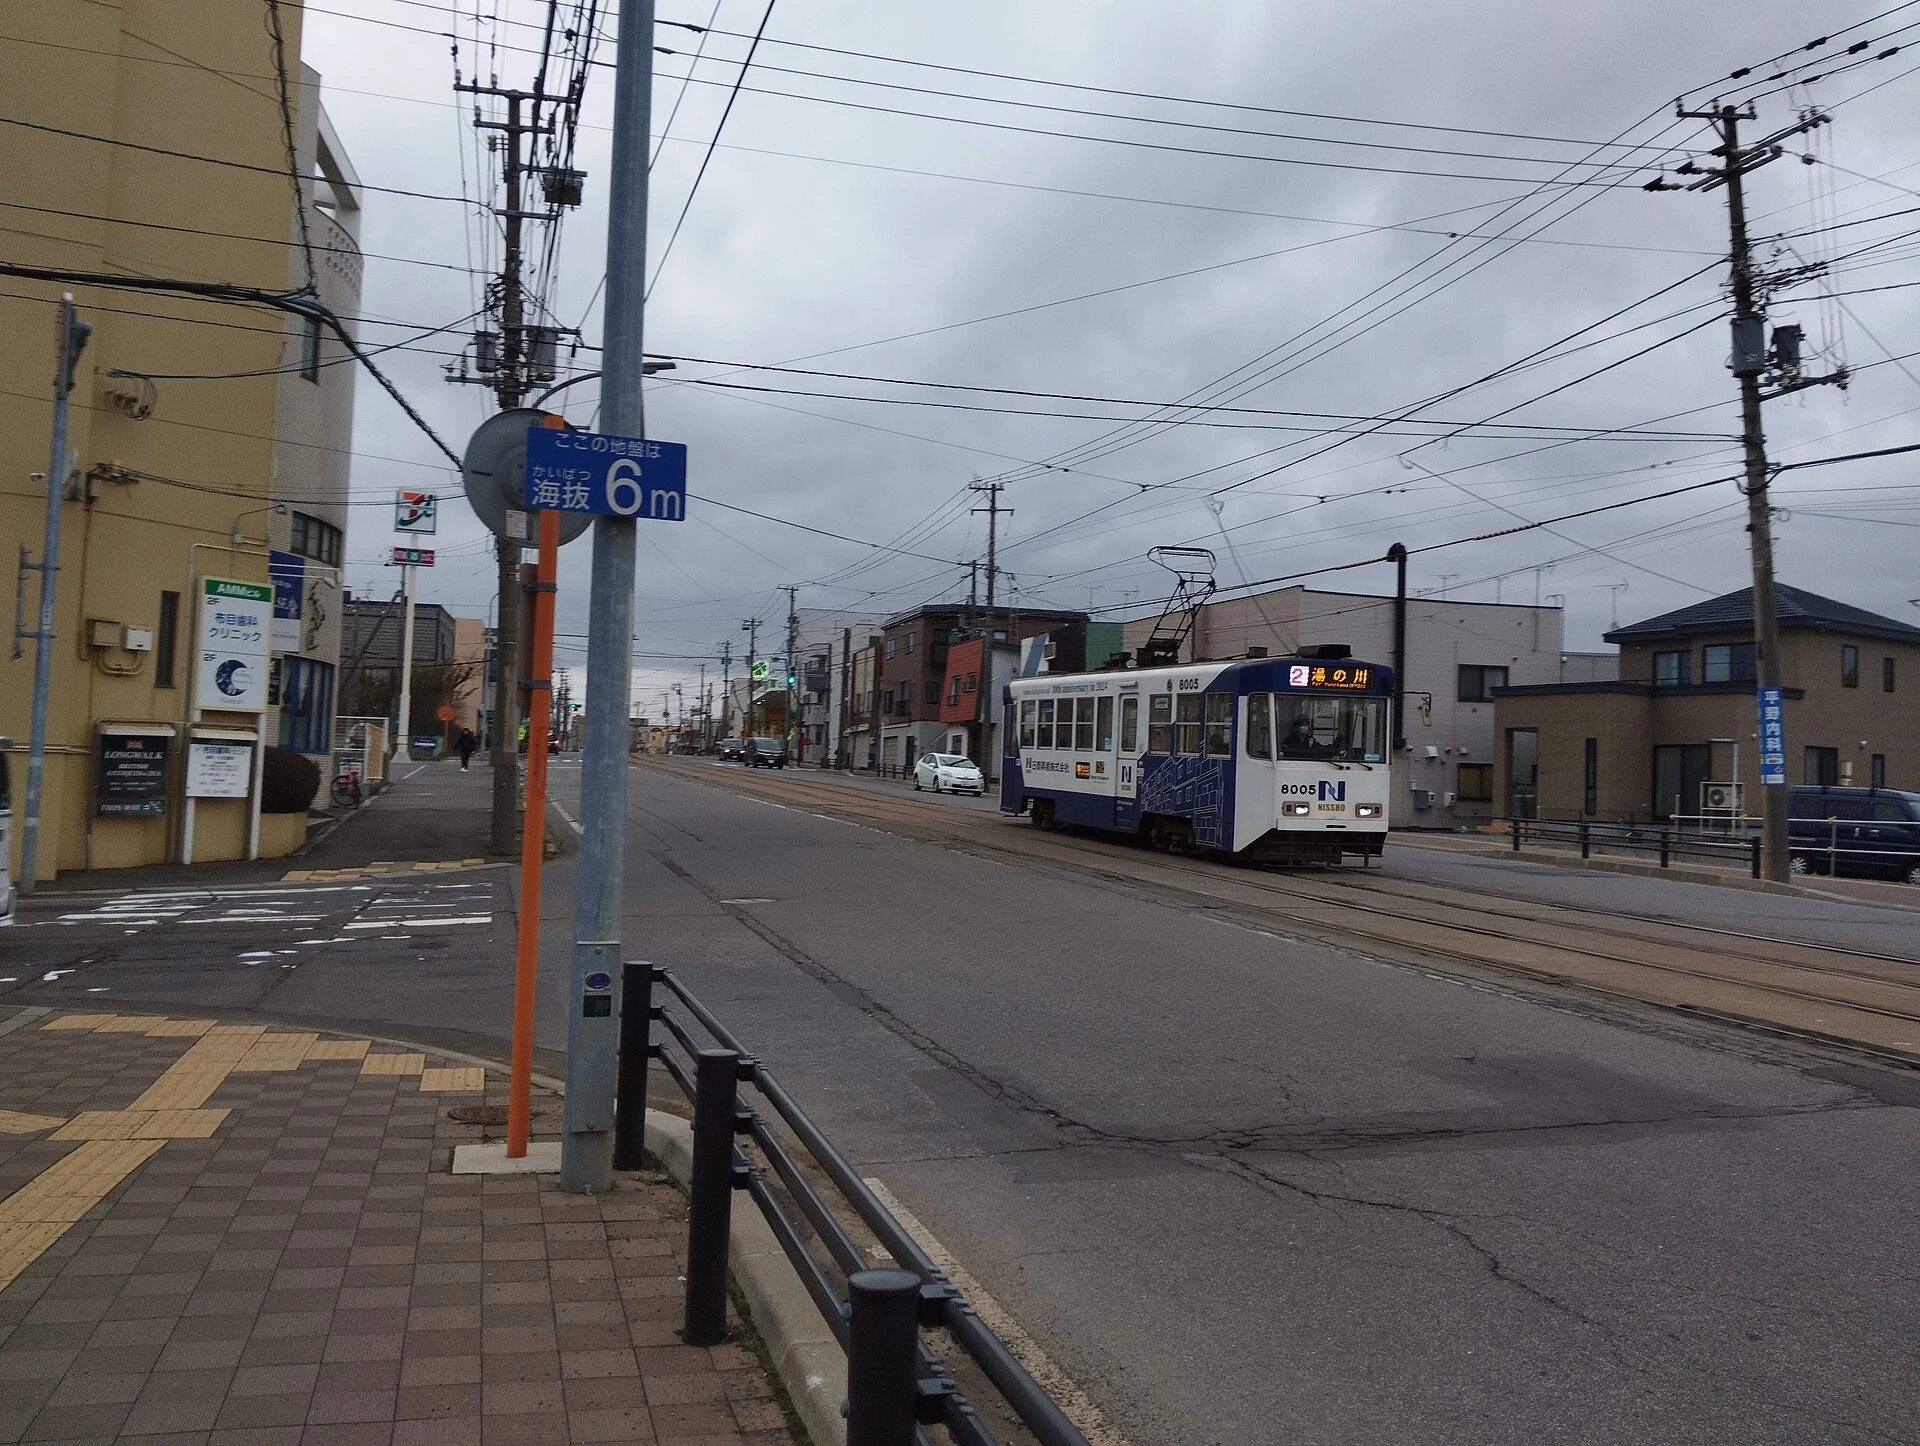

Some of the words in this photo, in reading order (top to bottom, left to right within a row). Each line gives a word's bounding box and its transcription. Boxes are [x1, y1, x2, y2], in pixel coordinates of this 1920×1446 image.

[555, 432, 662, 459] ここの地盤は
[532, 466, 591, 481] かいばつ
[532, 478, 591, 511] 海抜
[206, 596, 220, 605] 2F
[214, 612, 258, 628] 布目歯科
[208, 627, 262, 643] クリニック
[203, 653, 217, 662] 2F
[1291, 667, 1304, 684] 2
[1311, 667, 1368, 684] 湯の川
[1179, 678, 1199, 690] 8005
[1281, 784, 1316, 795] 8005
[1318, 803, 1346, 812] NISSHO
